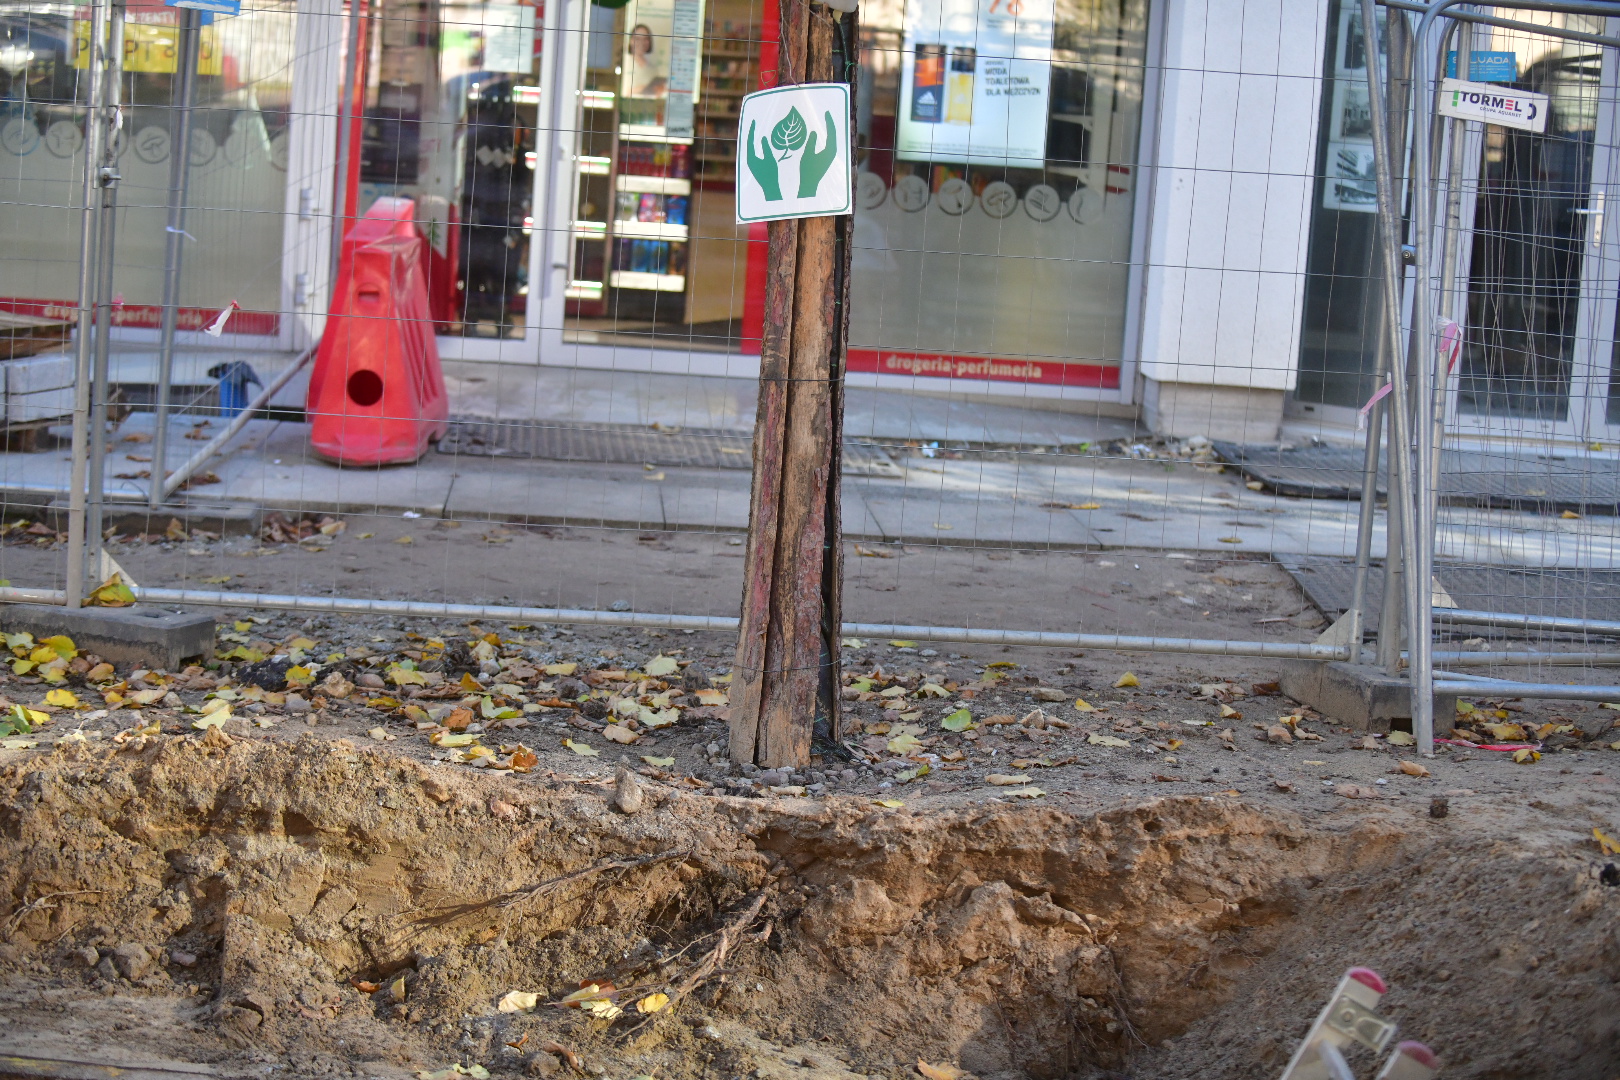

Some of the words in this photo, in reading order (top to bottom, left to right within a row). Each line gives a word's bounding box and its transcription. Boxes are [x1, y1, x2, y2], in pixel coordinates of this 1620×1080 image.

[1460, 91, 1522, 113] TORMEL
[1479, 106, 1497, 114] GRUPA
[886, 354, 1043, 379] drogeria-perfumeria
